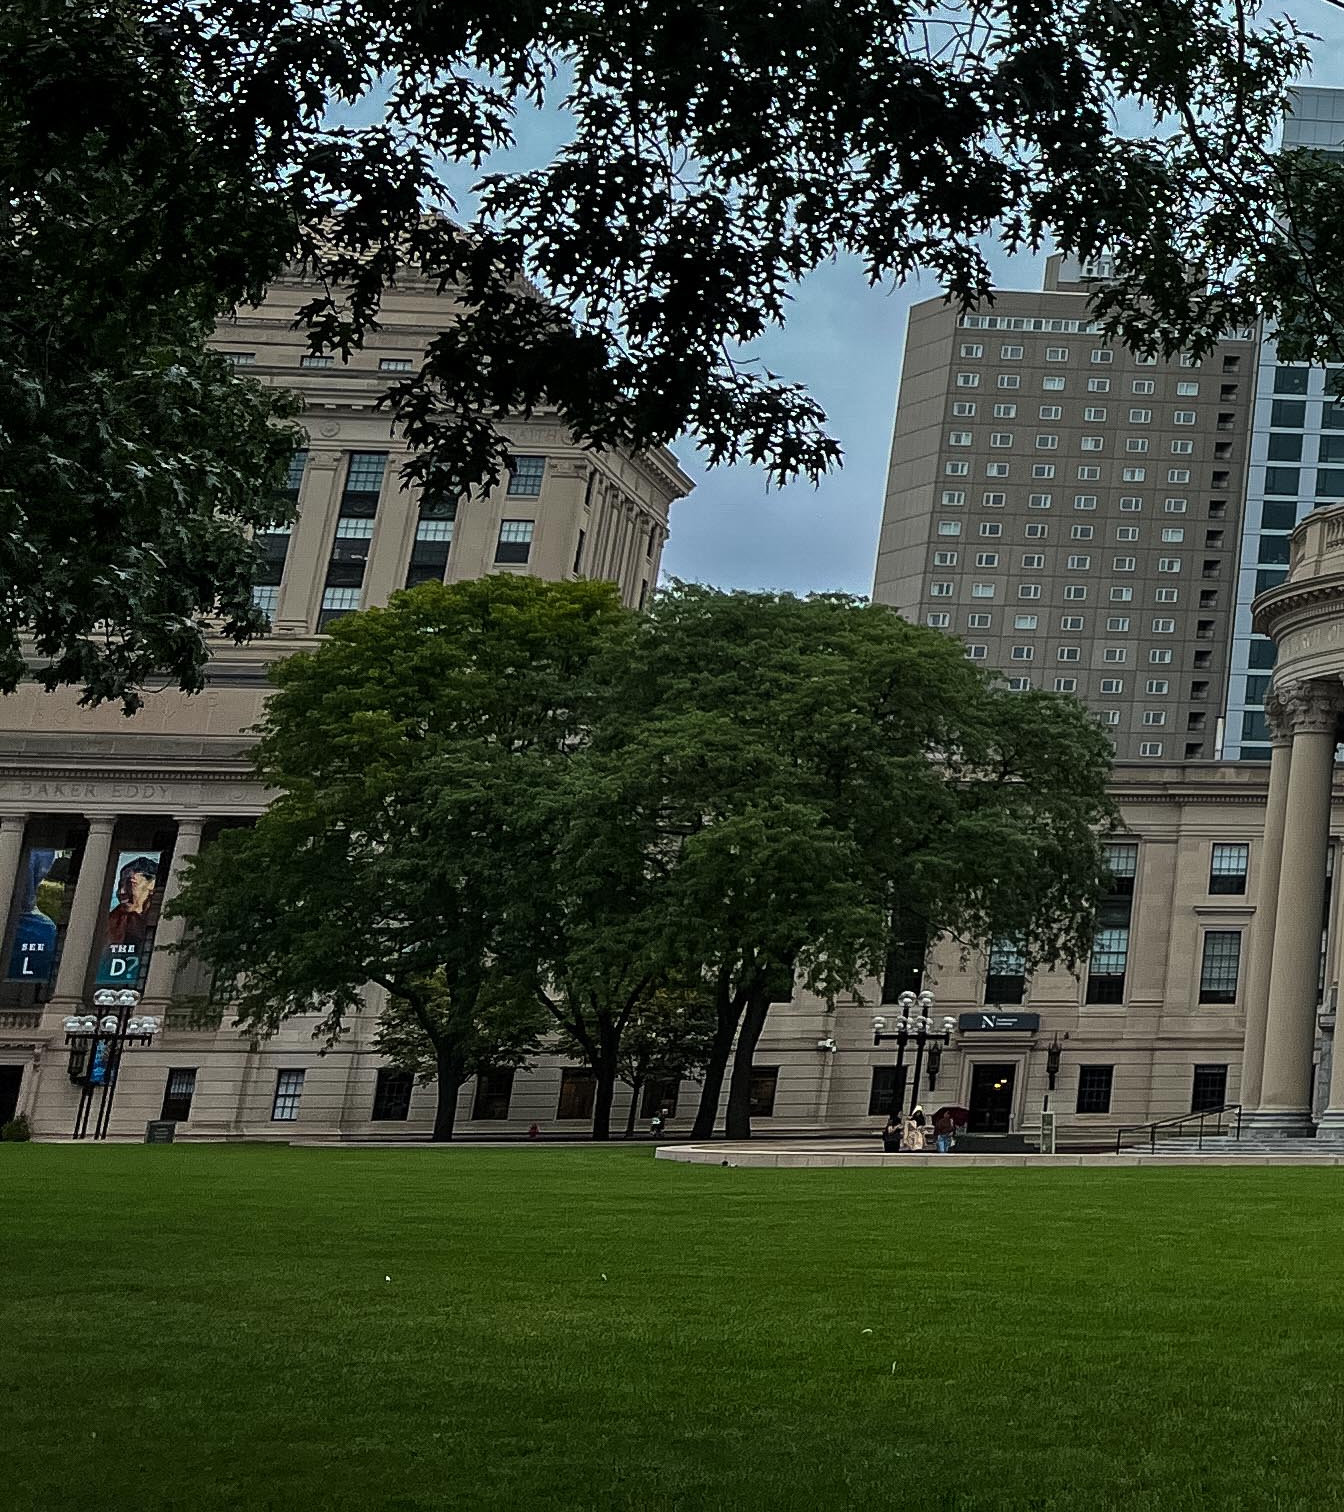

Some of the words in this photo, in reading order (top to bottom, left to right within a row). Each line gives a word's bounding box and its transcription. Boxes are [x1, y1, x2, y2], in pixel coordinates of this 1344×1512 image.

[20, 781, 97, 798] BAKER
[112, 785, 169, 799] EDDY
[21, 943, 45, 952] SEE
[110, 944, 136, 953] THE
[22, 956, 34, 975] L
[109, 956, 139, 979] D?
